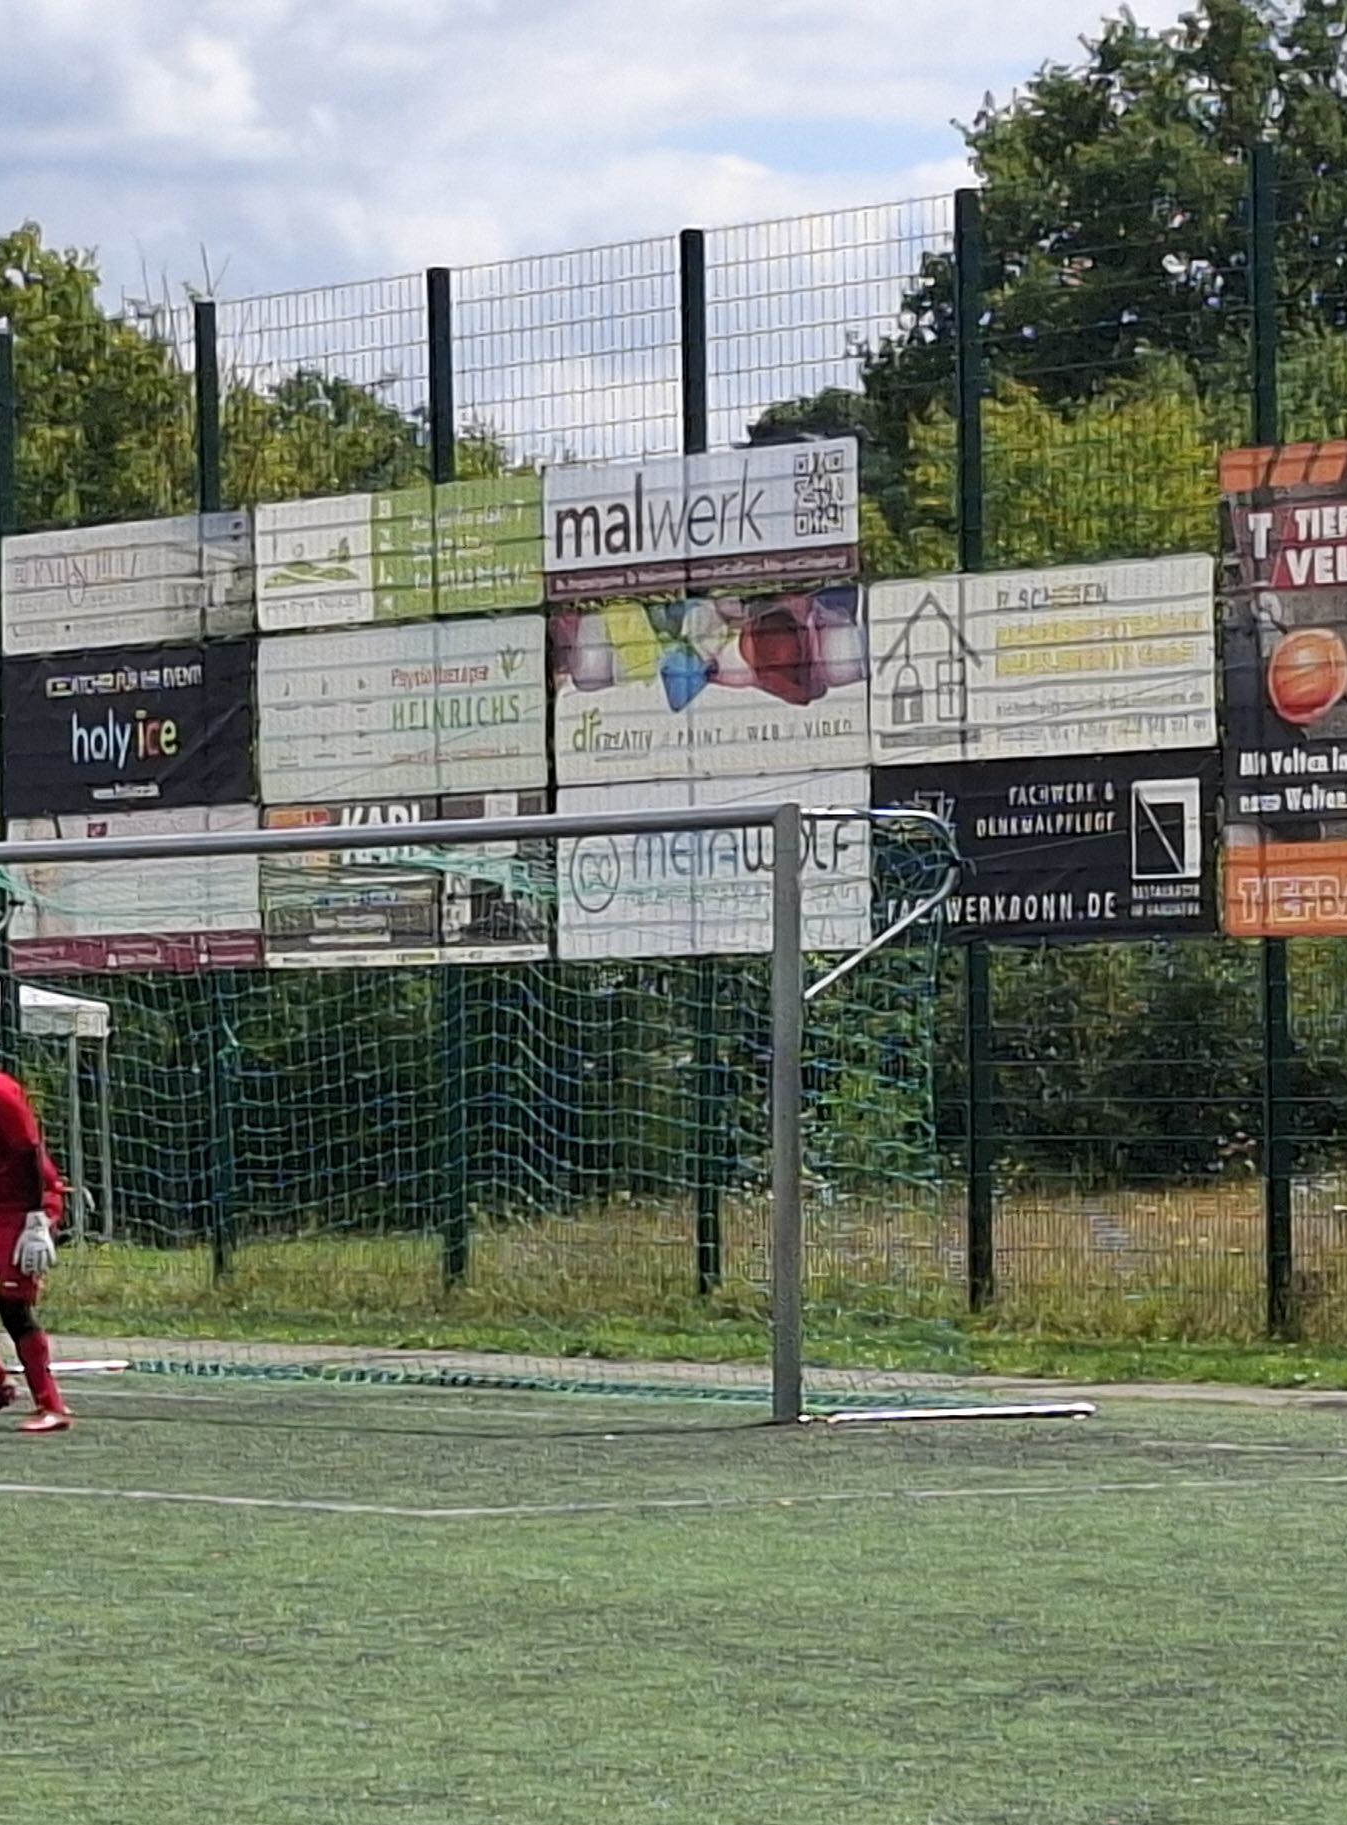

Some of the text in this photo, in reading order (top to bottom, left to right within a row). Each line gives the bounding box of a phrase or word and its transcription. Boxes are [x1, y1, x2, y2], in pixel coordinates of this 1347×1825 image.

[555, 458, 764, 559] malwerk
[392, 695, 520, 731] HEINRICHS
[72, 708, 178, 770] holy ice
[1271, 747, 1330, 775] Velten
[1009, 782, 1097, 806] FACHWERK
